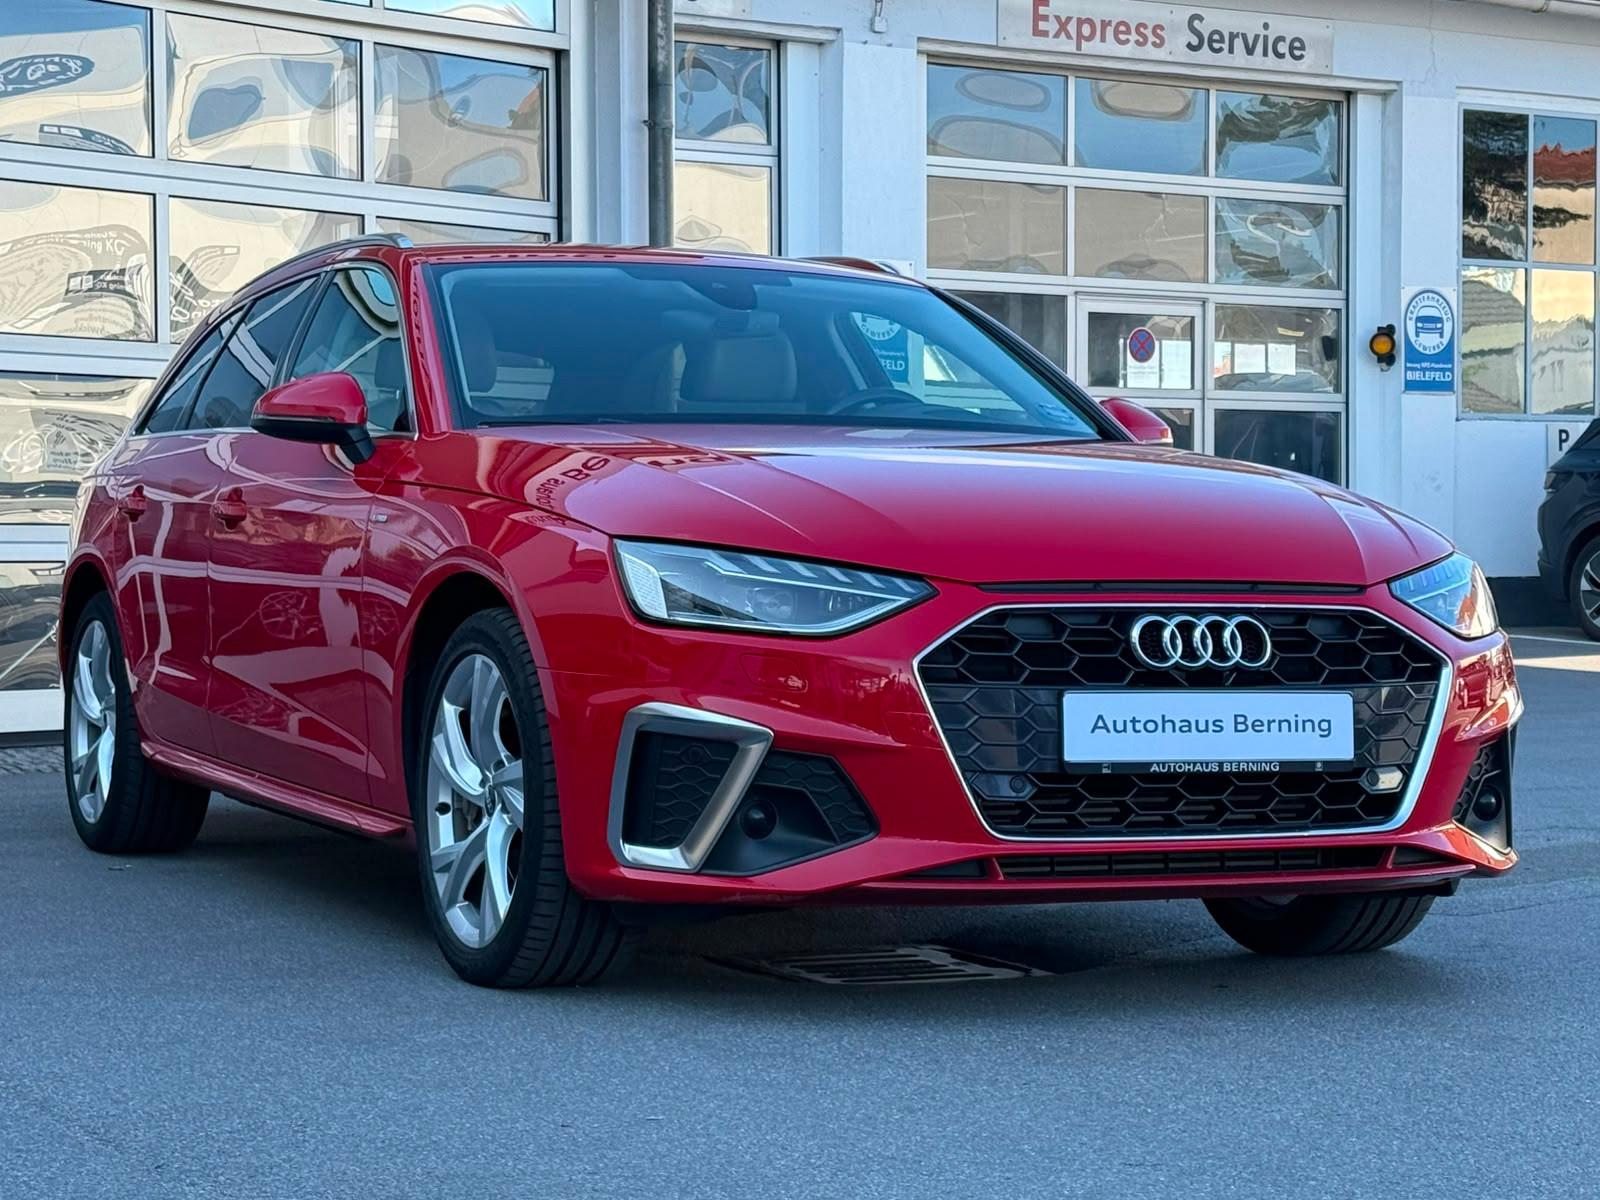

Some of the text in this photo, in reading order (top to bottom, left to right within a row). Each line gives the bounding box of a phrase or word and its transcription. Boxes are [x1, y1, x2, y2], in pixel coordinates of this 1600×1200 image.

[1032, 0, 1306, 61] Express Service
[1406, 370, 1452, 381] BIELEFELD
[1090, 713, 1332, 738] Autohaus Berning
[1150, 761, 1280, 773] AUTOHAUS BERNING
